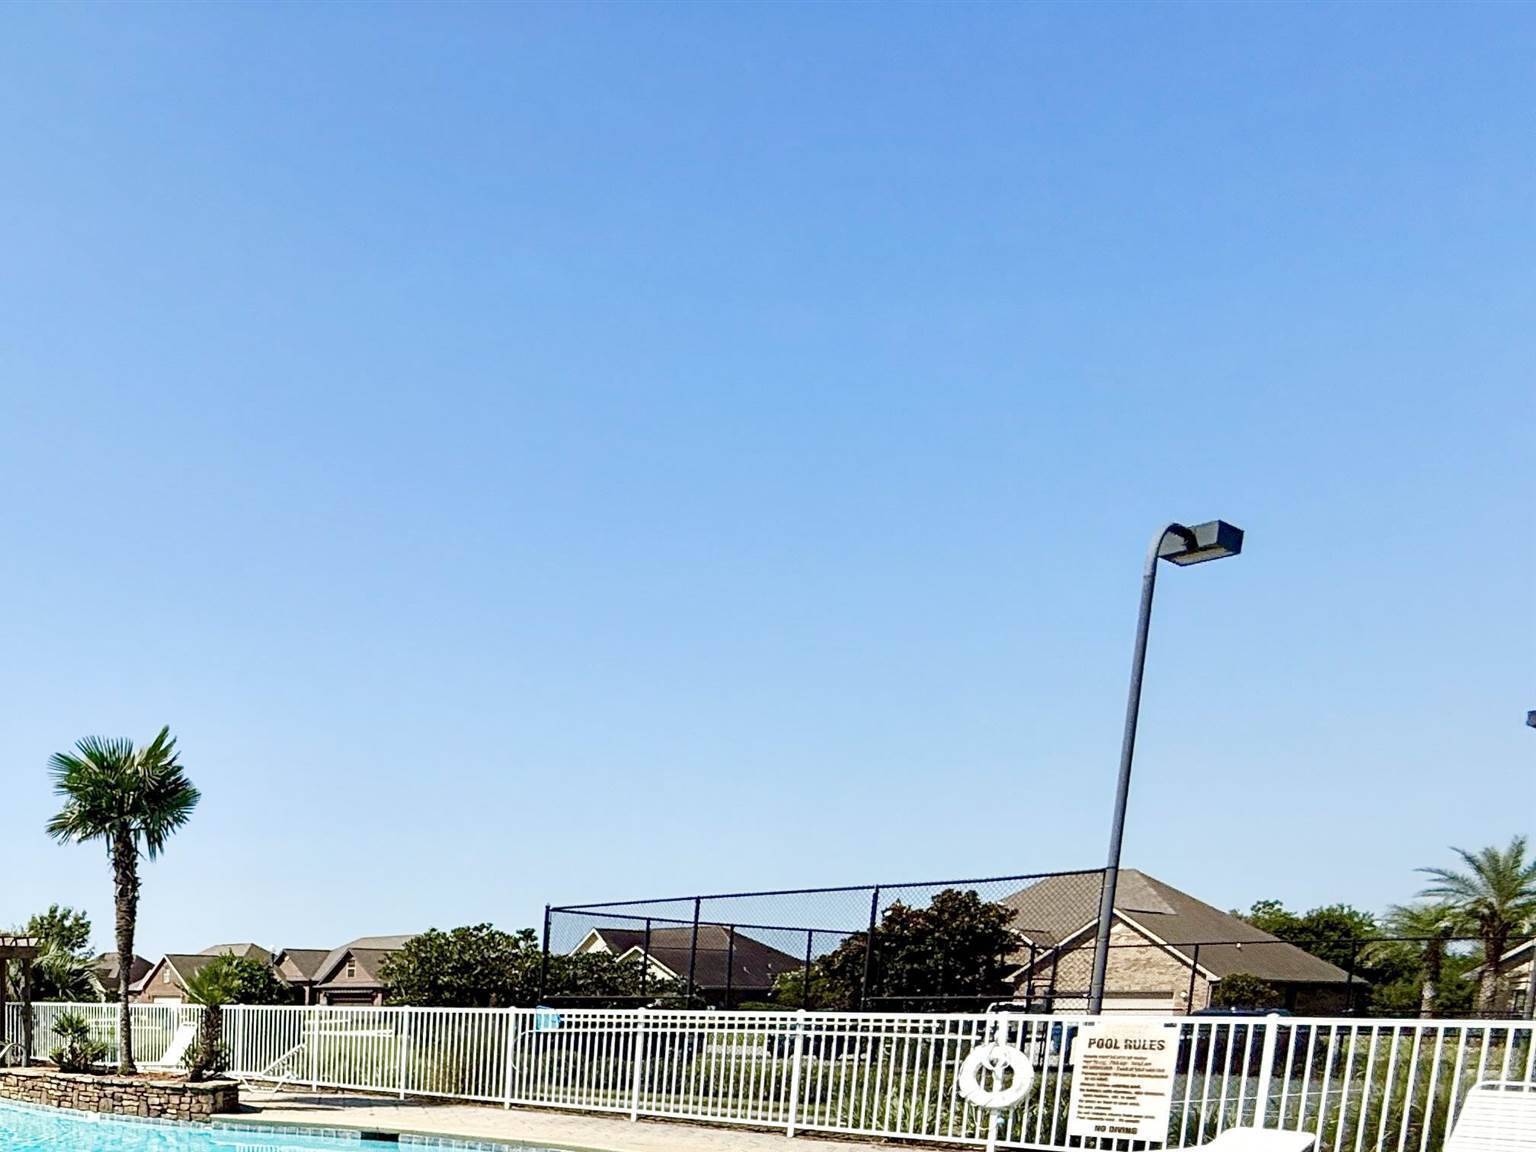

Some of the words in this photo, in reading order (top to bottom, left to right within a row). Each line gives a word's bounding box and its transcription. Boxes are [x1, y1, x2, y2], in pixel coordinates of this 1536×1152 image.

[1088, 1038, 1120, 1051] POOL
[1124, 1039, 1166, 1051] RULES
[1095, 1125, 1107, 1133] NO
[1109, 1126, 1138, 1135] DIVING
